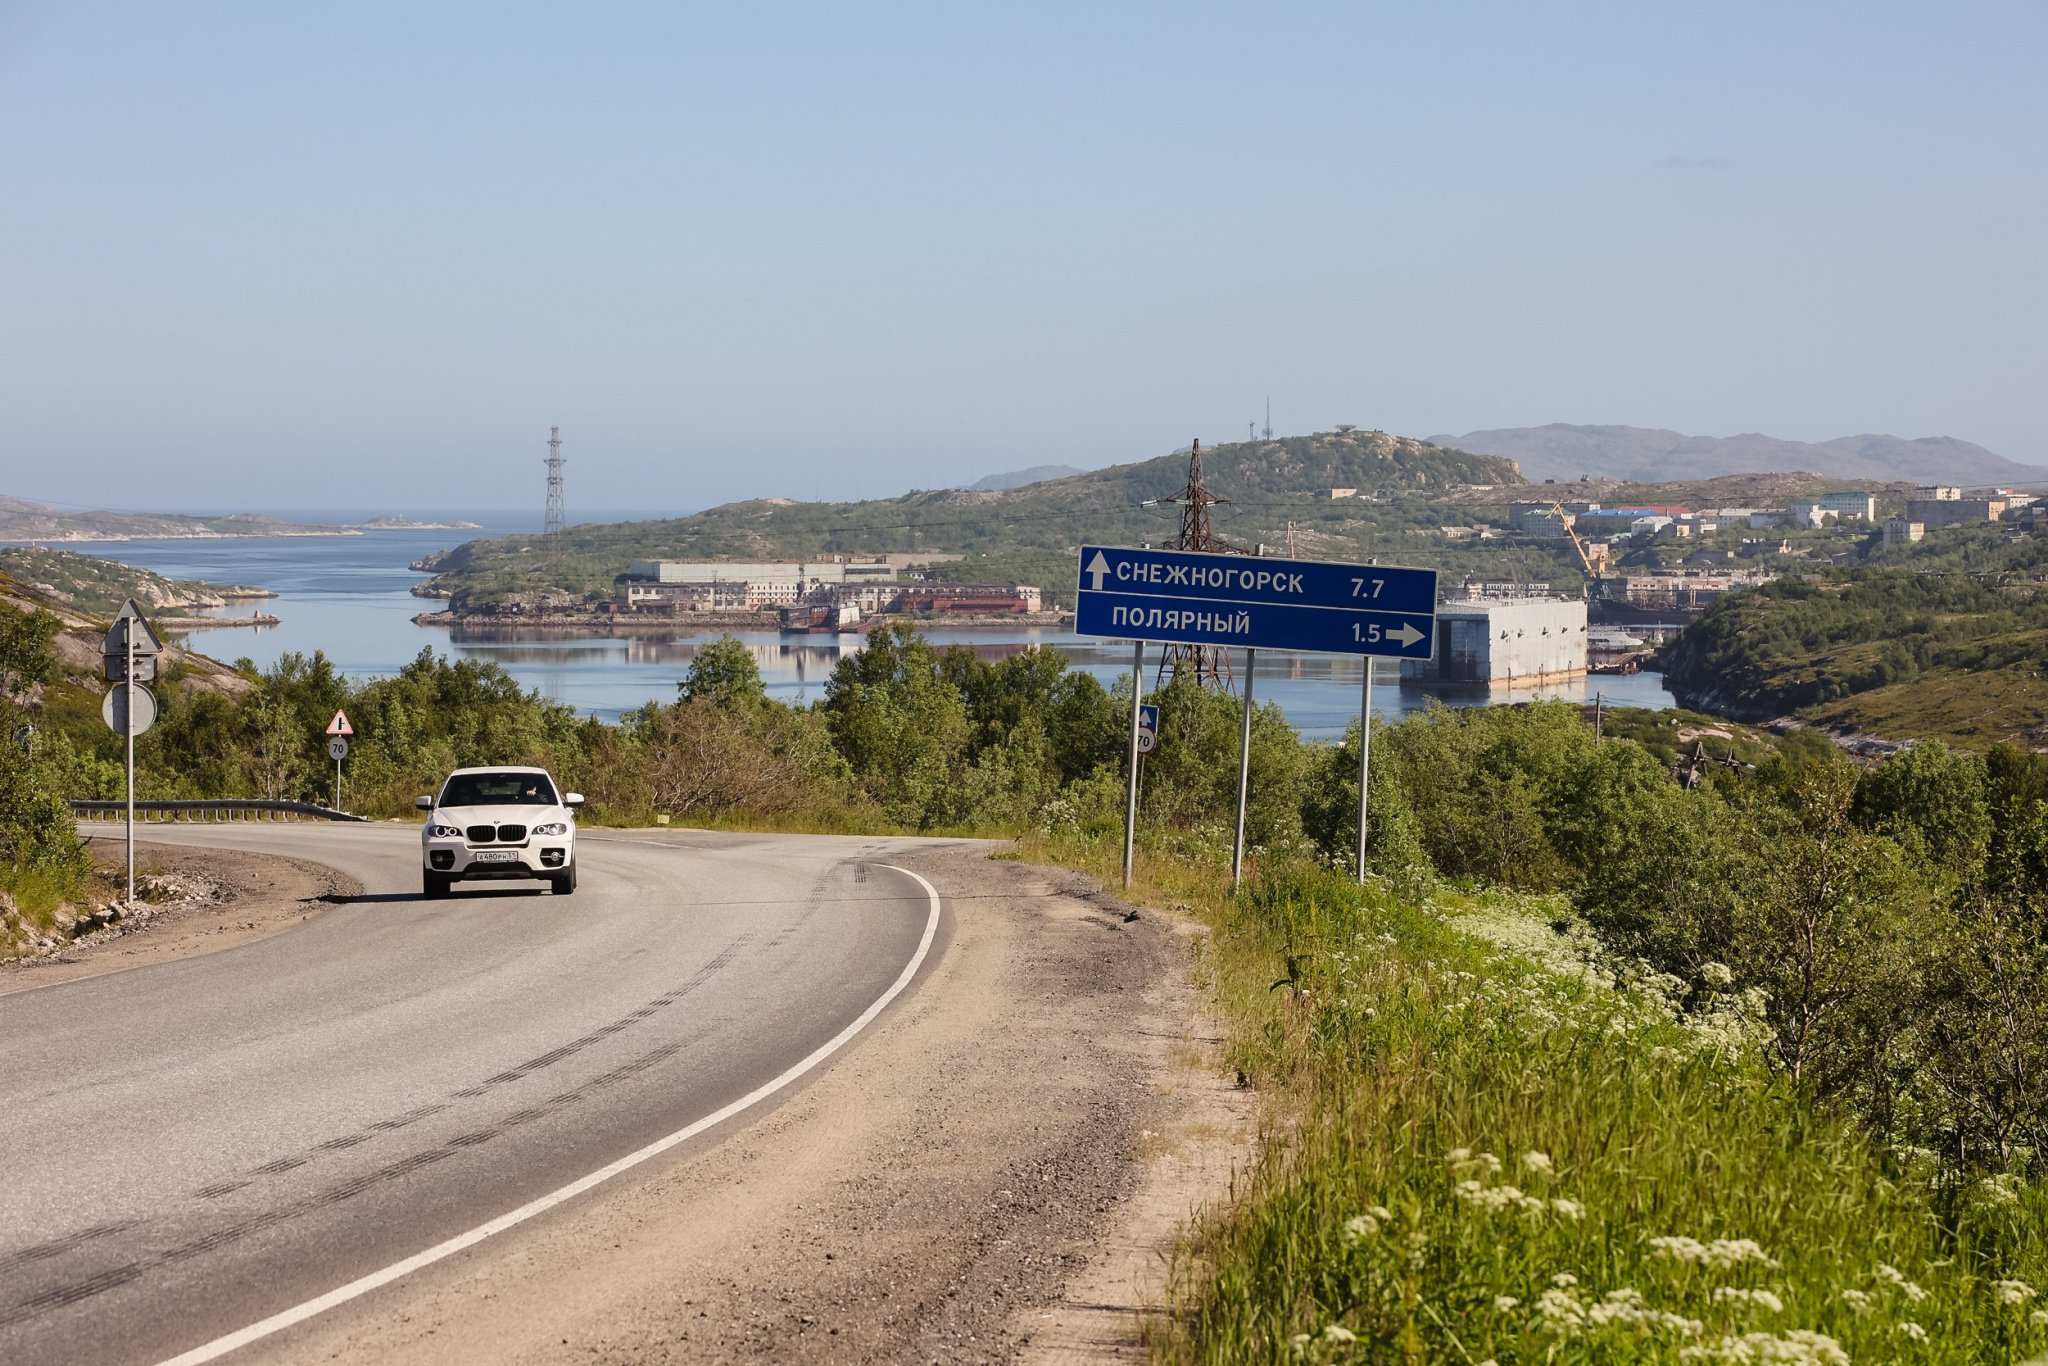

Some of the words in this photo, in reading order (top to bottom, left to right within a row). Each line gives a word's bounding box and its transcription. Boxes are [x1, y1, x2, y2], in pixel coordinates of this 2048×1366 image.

[1116, 561, 1304, 594] СНЕЖНОГОРСК
[1351, 578, 1384, 598] 7.7
[1112, 606, 1250, 634] ПОЛЯРНЫЙ
[1352, 623, 1380, 643] 1.5
[332, 743, 344, 754] 70
[1138, 735, 1150, 747] 70
